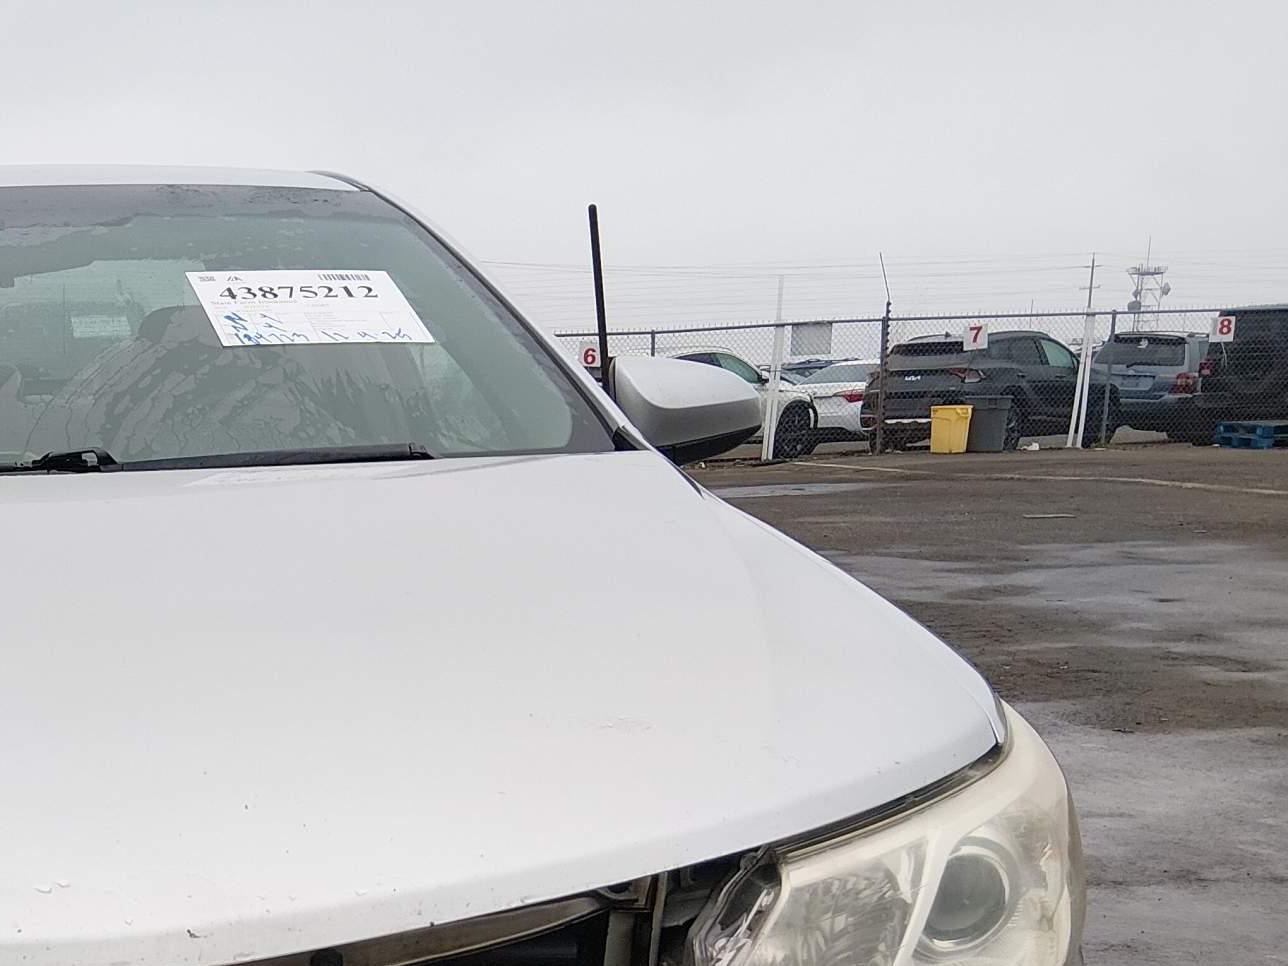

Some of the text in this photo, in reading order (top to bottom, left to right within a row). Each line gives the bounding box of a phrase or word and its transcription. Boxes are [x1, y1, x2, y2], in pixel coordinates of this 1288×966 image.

[219, 285, 379, 300] 43875212
[969, 326, 983, 343] 7
[1219, 318, 1232, 335] 8
[583, 347, 596, 365] 6
